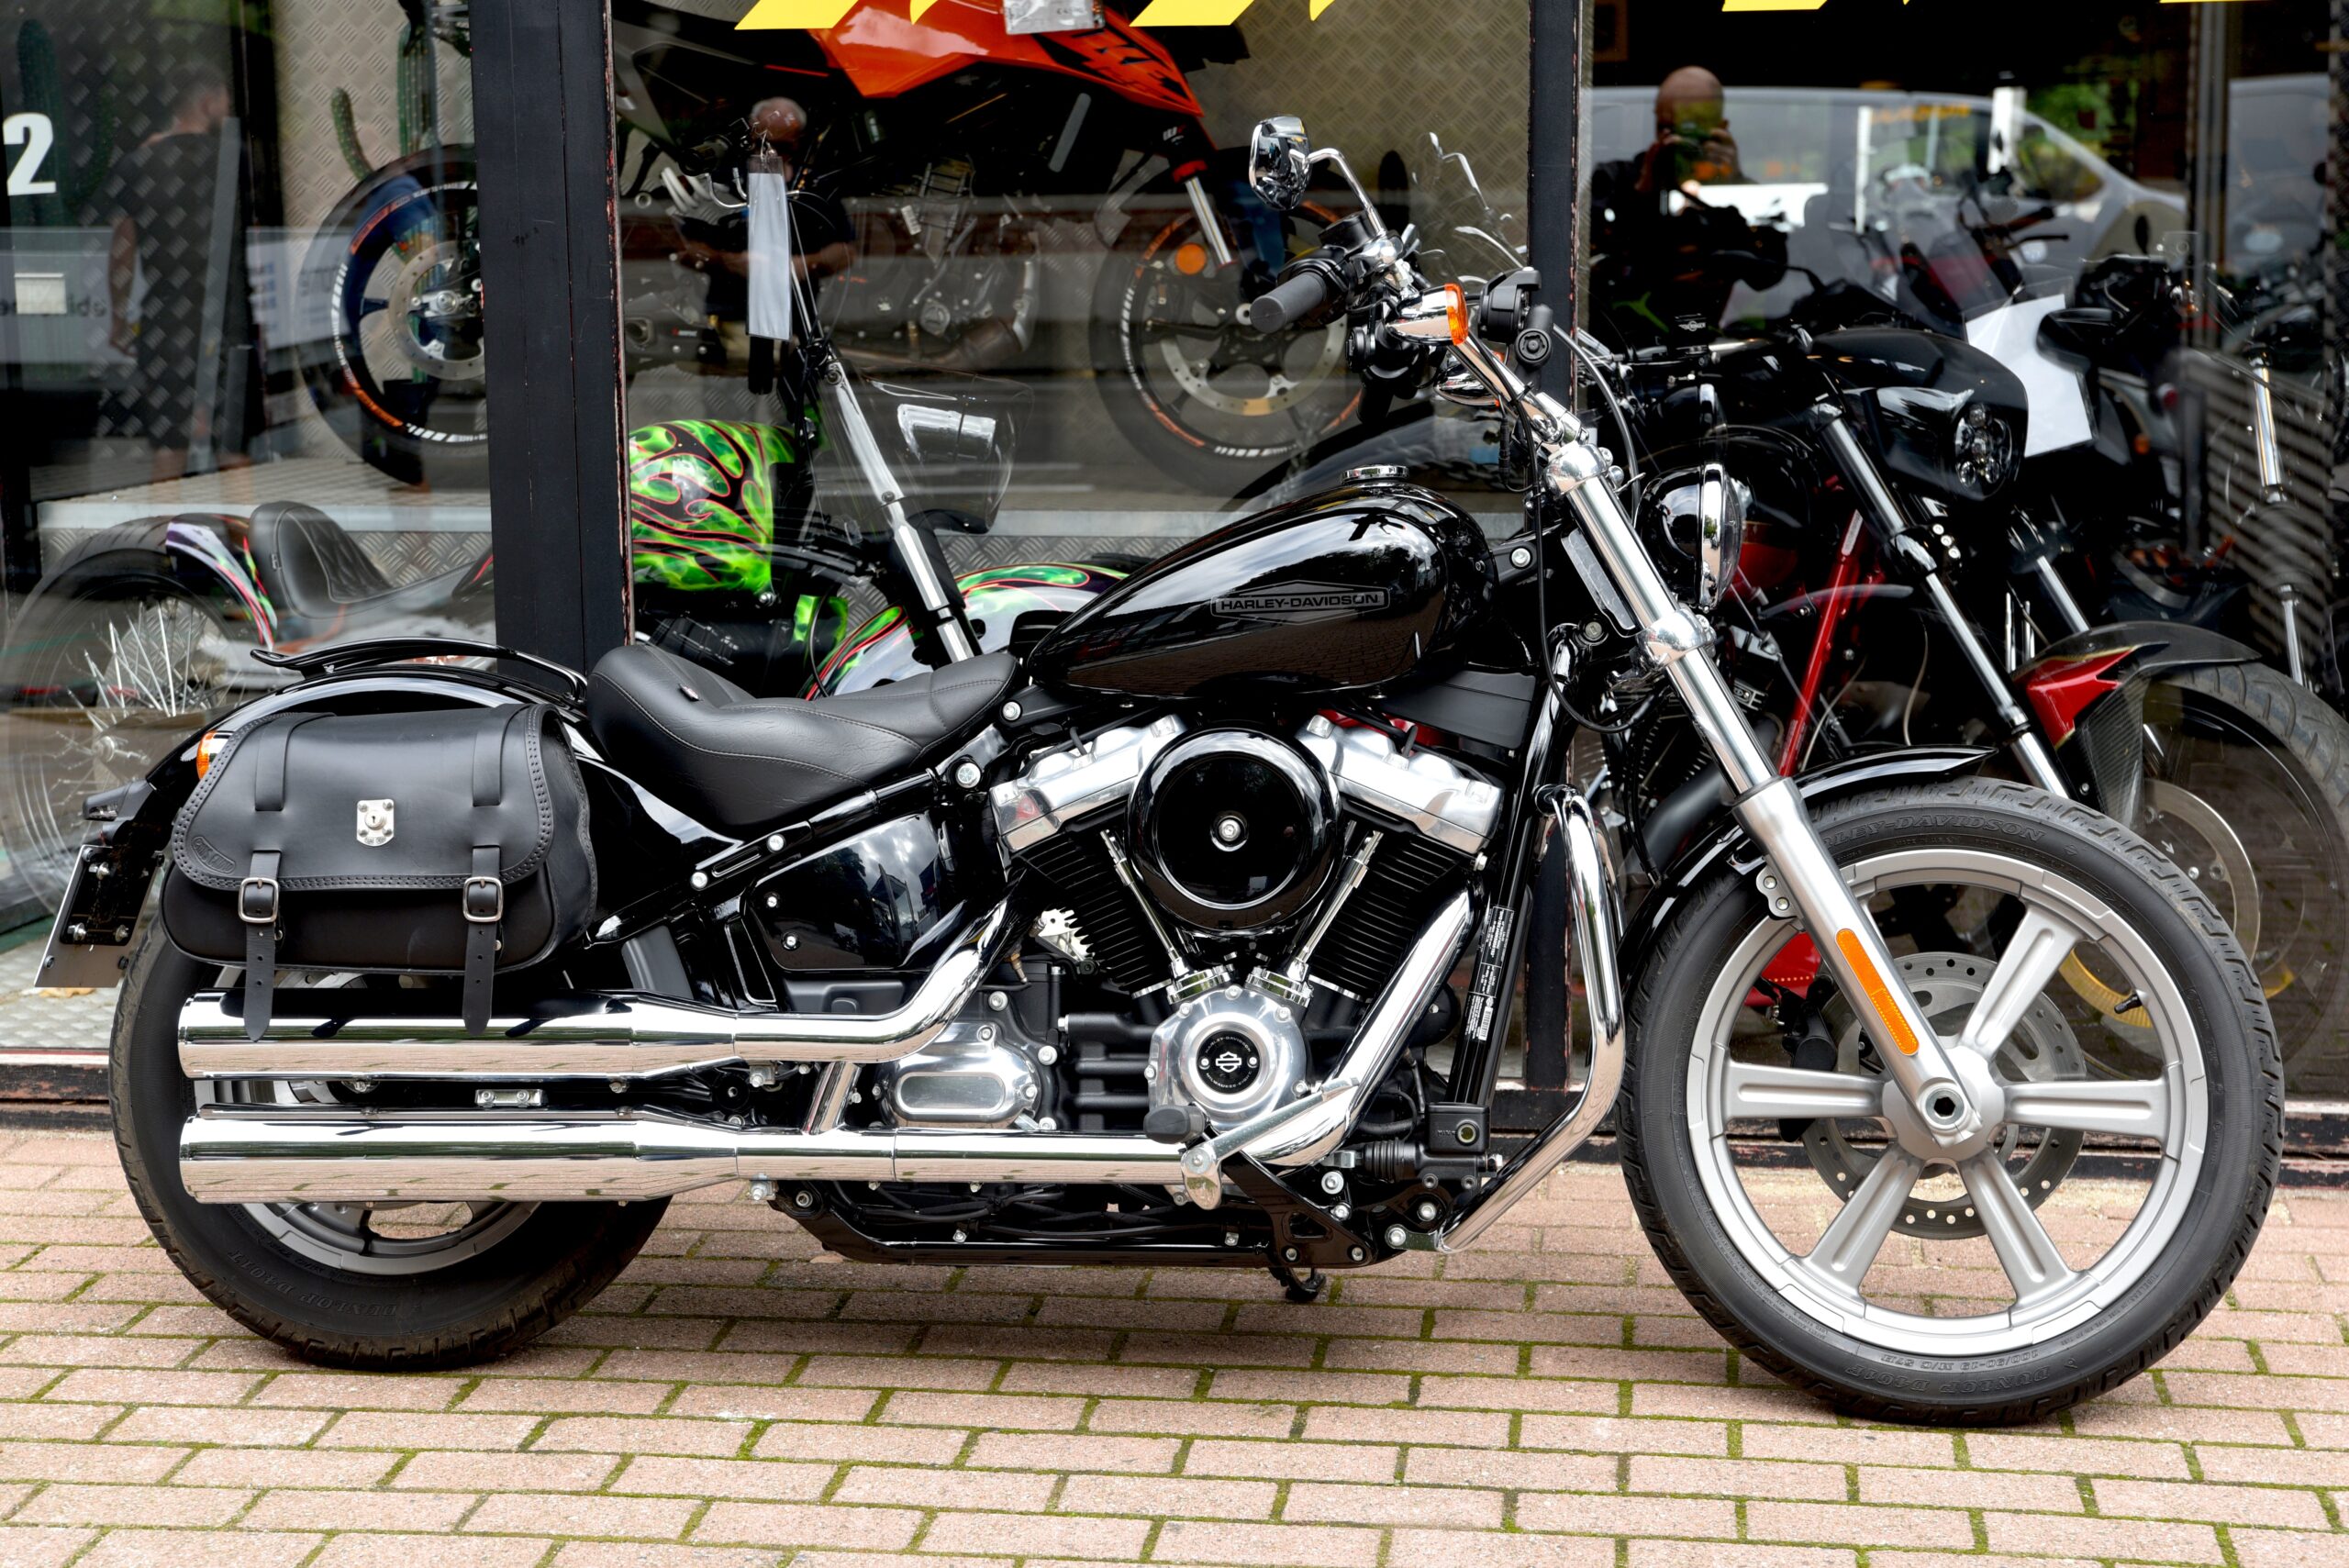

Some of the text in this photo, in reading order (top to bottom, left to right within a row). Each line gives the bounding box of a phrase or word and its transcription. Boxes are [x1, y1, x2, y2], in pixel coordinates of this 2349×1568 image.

[3, 112, 57, 195] 2
[1221, 594, 1379, 610] HARLEY-DAVIDSON
[1823, 814, 2047, 851] LEY-DAVIDSON
[1205, 1036, 1252, 1053] HARLEY-DAVIDSON
[299, 1292, 397, 1316] DUNLOP
[1920, 1362, 1954, 1371] M/C
[1961, 1350, 2039, 1371] 100/90-19
[1845, 1363, 2051, 1394] DUNLOP D401F
